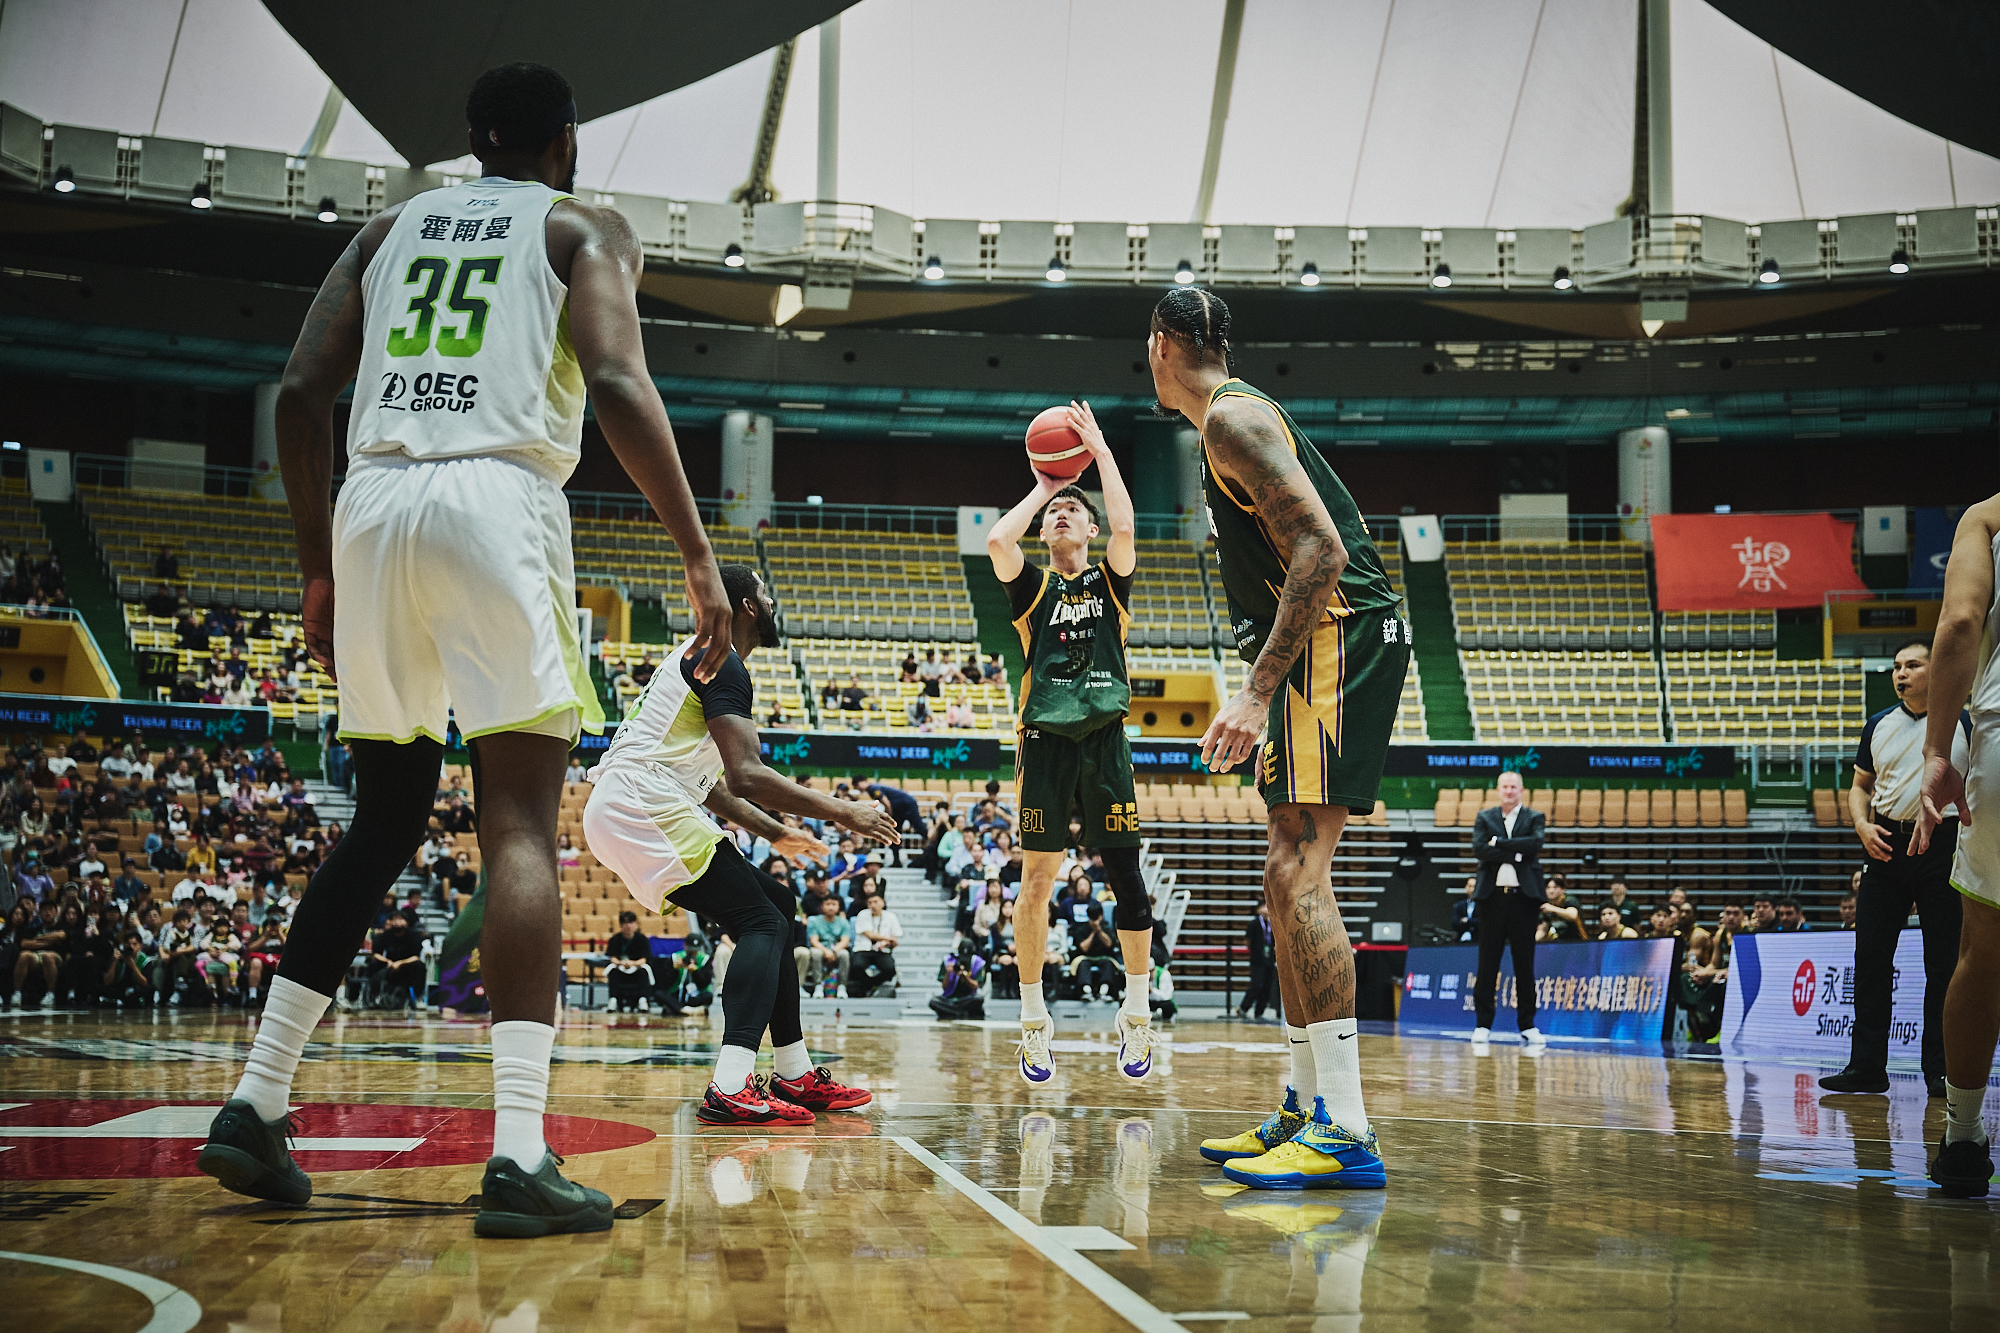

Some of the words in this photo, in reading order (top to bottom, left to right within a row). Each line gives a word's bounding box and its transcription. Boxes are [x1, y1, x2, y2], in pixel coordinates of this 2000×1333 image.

[420, 214, 513, 243] 霍爾曼
[386, 255, 505, 358] 35
[413, 372, 479, 398] OEC
[410, 396, 476, 414] GROUP
[1021, 808, 1045, 833] 31
[1105, 814, 1139, 832] ONE
[1816, 1012, 1855, 1038] SinoPa
